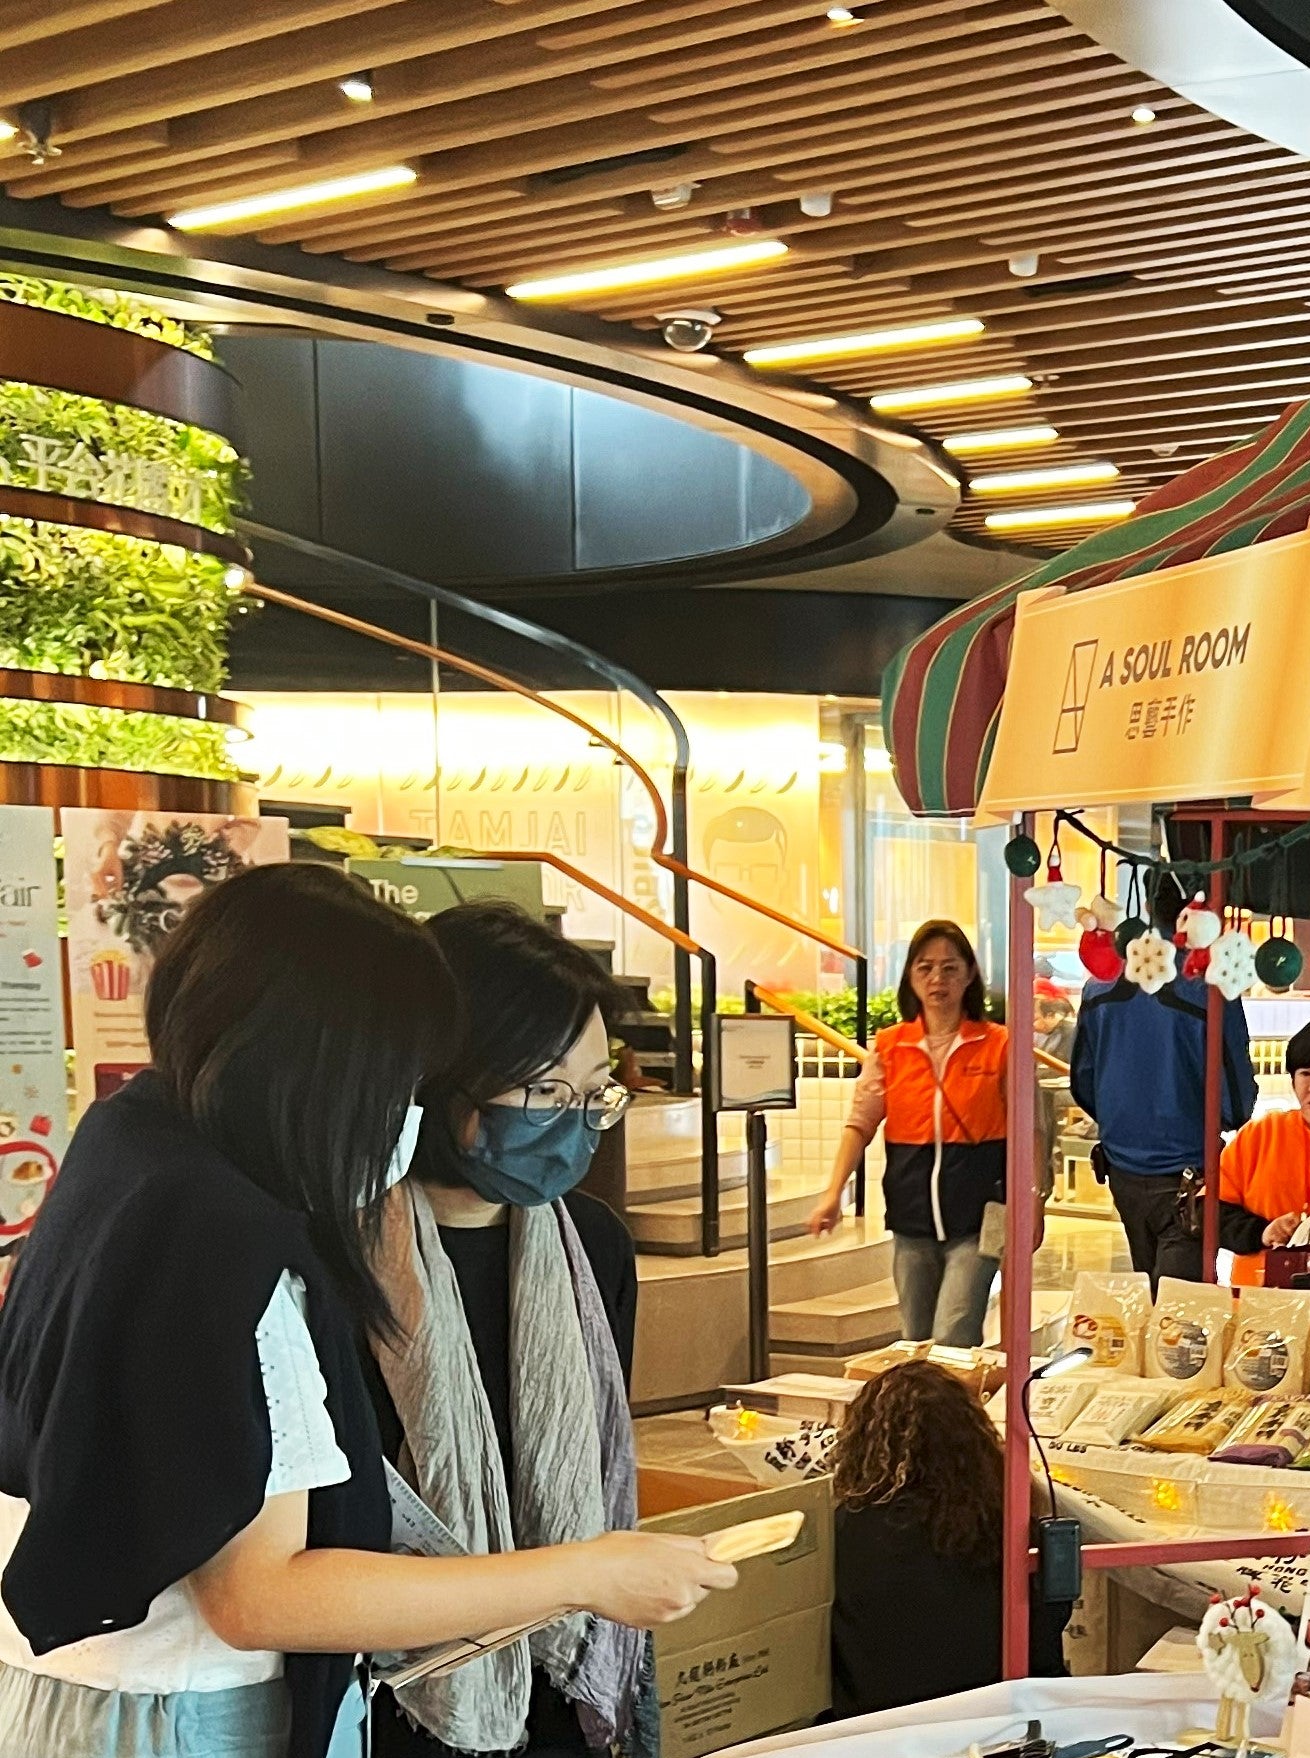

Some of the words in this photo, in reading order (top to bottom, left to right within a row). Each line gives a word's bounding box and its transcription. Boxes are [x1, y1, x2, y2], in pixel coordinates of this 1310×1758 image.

[1099, 651, 1114, 689] A
[1120, 639, 1172, 686] SOUL
[1178, 622, 1252, 676] ROOM
[409, 809, 588, 858] TAMJAI
[0, 877, 41, 907] air
[369, 879, 420, 905] The
